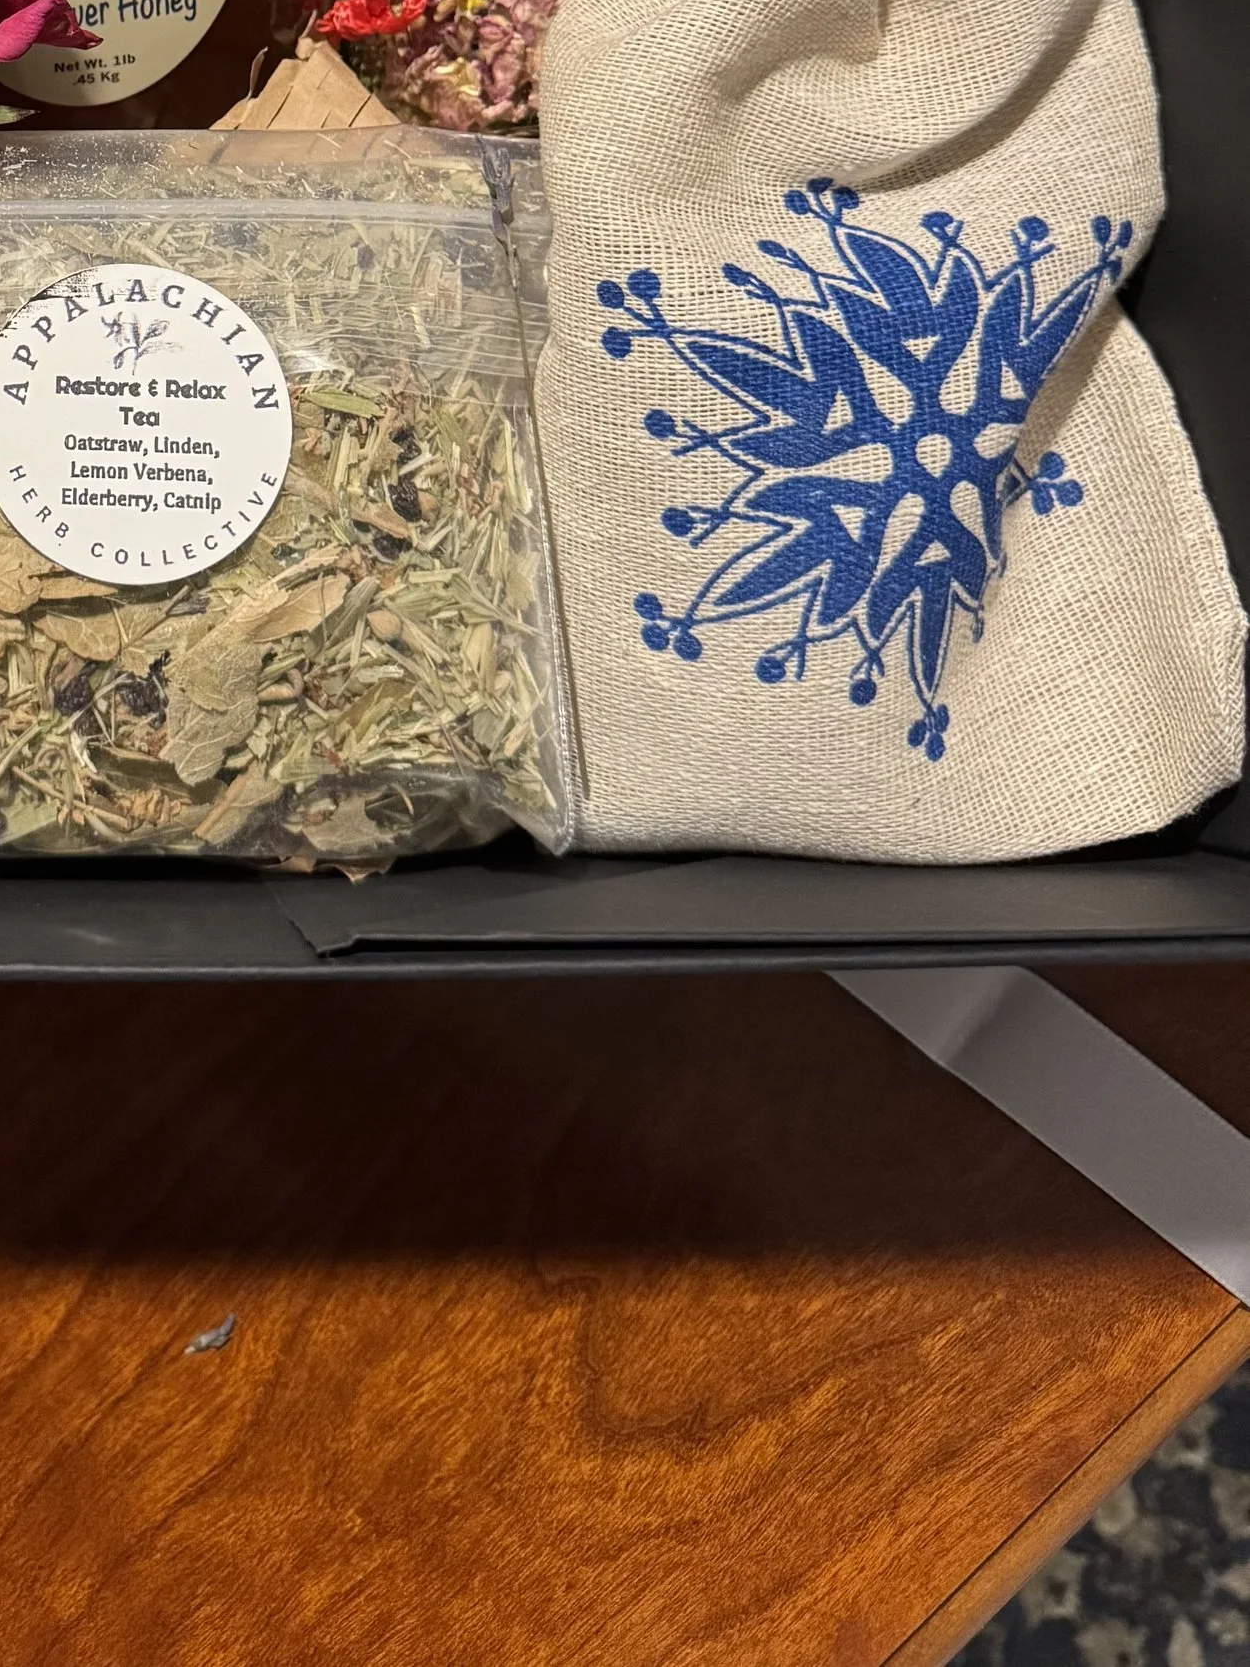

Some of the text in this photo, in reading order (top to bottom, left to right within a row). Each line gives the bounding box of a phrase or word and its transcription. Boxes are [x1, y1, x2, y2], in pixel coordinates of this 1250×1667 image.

[54, 54, 136, 74] Net Wt. 1lb
[73, 70, 120, 86] .45 Kg
[3, 279, 279, 410] APPALACHIAN
[55, 376, 227, 400] Restore & Relax
[119, 406, 160, 427] Tea
[64, 434, 220, 459] Oatstraw, Linden,
[70, 461, 213, 485] Lemon Verbena,
[61, 488, 222, 514] Elderberry, Catnip
[9, 464, 277, 567] HERB COLLECTIVE
